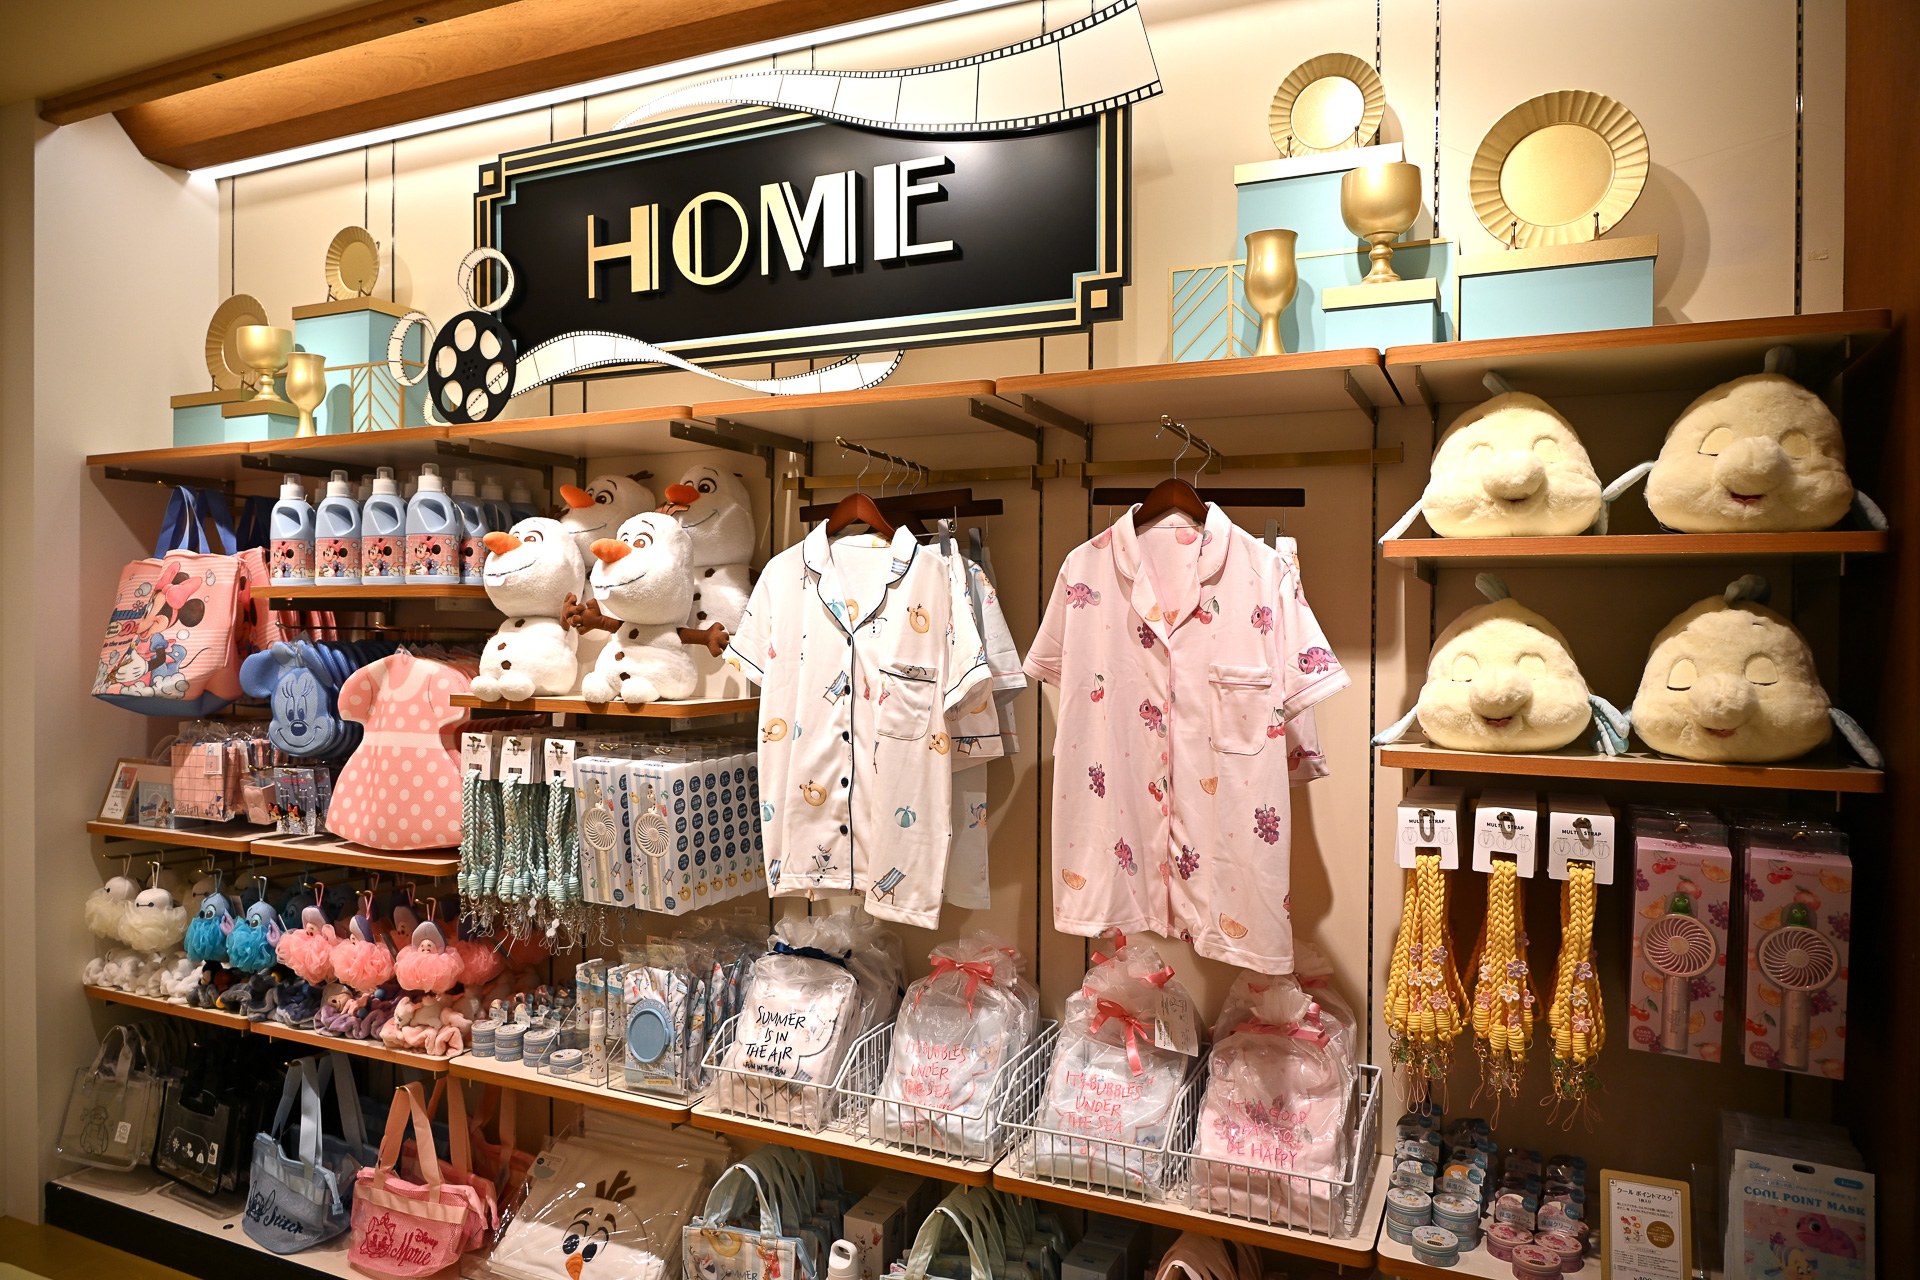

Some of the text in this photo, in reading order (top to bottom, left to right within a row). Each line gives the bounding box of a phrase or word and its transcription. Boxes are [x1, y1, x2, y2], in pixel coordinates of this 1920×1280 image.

[587, 154, 955, 299] HOME
[756, 1006, 806, 1029] SUMMER
[764, 1028, 788, 1044] IS IN
[746, 1043, 792, 1066] THE AIR
[922, 1041, 968, 1063] BUBBLES
[911, 1062, 949, 1080] UNDER
[902, 1079, 952, 1100] THE SEA
[1066, 1070, 1144, 1101] IT'S BUBBLES
[1076, 1096, 1122, 1116] UNDER
[1254, 1100, 1266, 1117] A
[1268, 1107, 1308, 1125] GOOD
[1064, 1112, 1124, 1134] THE SEA
[1242, 1120, 1293, 1142] DAY TO
[1226, 1135, 1298, 1168] BE HAPPY
[1746, 1160, 1772, 1172] Disney
[1616, 1188, 1672, 1202] クール ポイントマスク
[1744, 1186, 1778, 1200] COOL
[1783, 1193, 1822, 1208] POINT
[1826, 1201, 1866, 1216] MASK
[263, 1206, 304, 1235] Stitch
[390, 1232, 432, 1266] Marie
